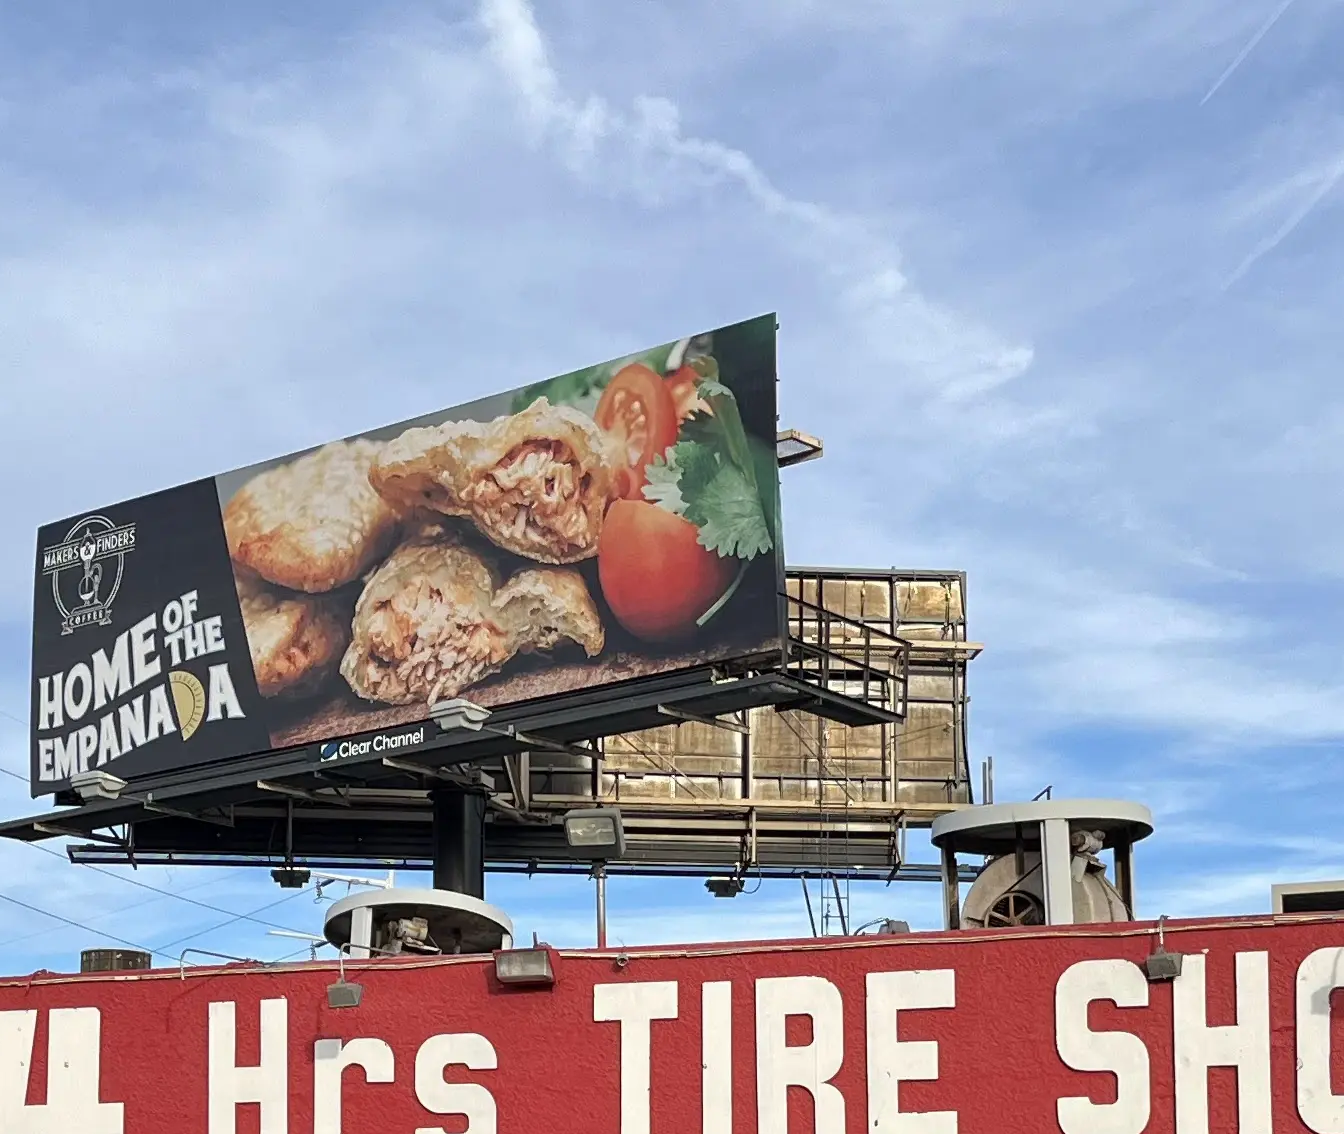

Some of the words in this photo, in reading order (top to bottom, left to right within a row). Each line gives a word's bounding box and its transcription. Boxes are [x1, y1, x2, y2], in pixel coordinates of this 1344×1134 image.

[43, 546, 79, 568] MAKERS
[96, 530, 136, 552] FINDERS
[68, 610, 104, 627] COFFEE
[162, 589, 199, 634] OF
[164, 615, 227, 667] THE
[38, 612, 161, 731] HOME
[338, 741, 372, 758] Clear
[372, 727, 424, 751] Channel
